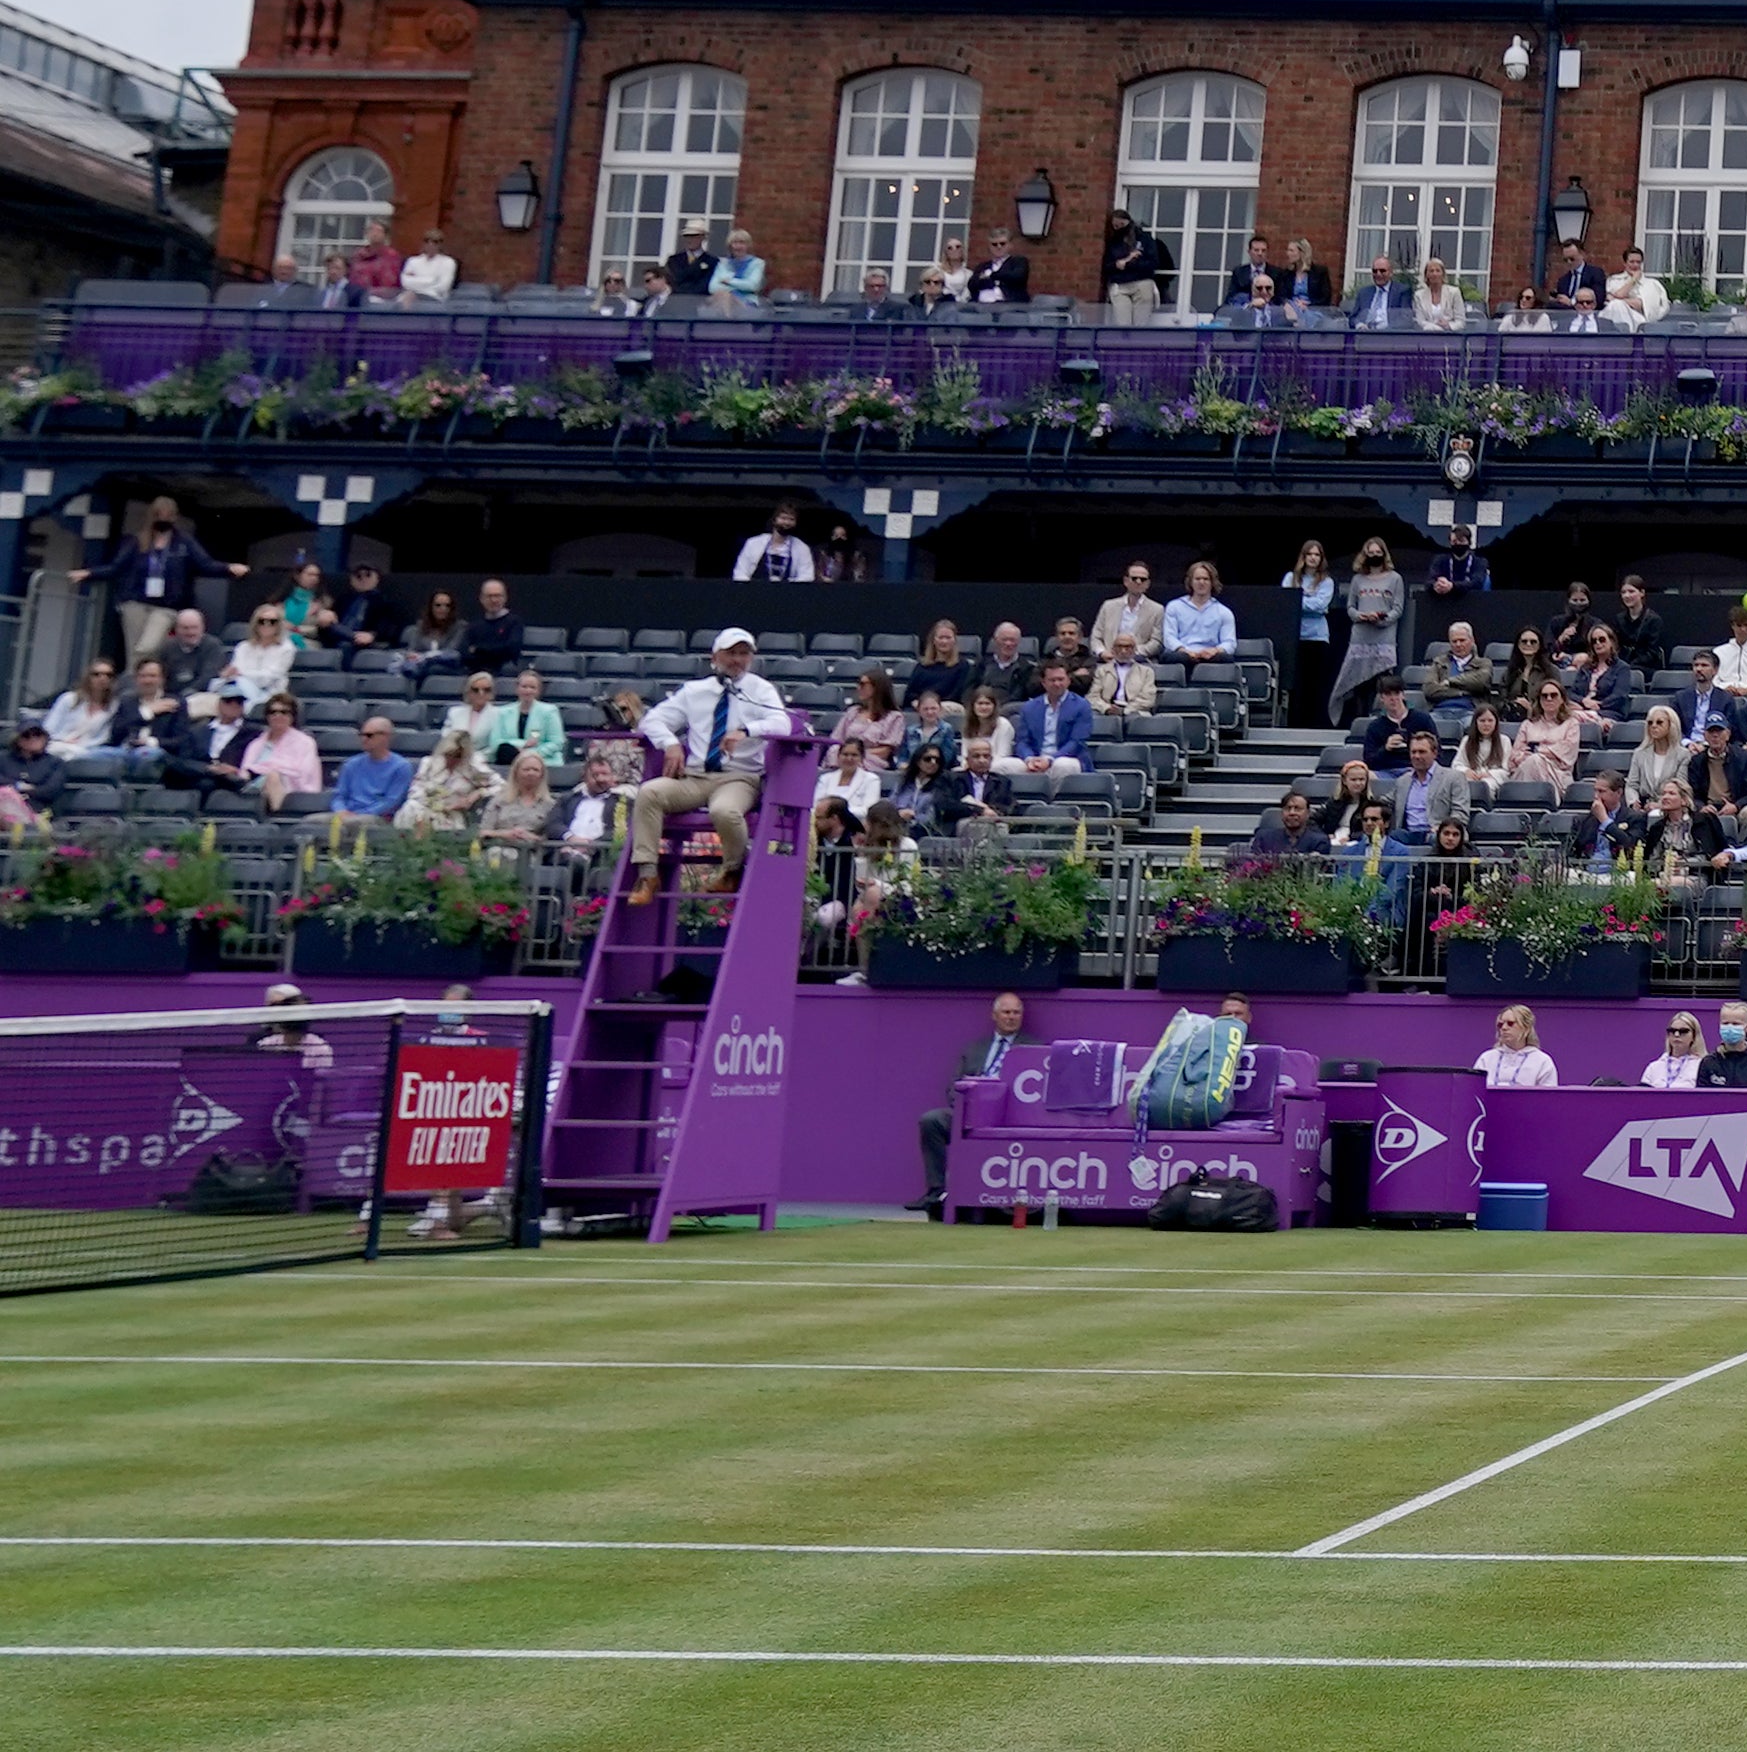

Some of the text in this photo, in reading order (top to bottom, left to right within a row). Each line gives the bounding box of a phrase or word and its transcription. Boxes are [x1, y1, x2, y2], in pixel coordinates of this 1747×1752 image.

[714, 1014, 785, 1076] cinch
[1212, 1026, 1243, 1103] HEAD
[398, 1071, 511, 1119] Emirates
[407, 1127, 439, 1166] FLY
[980, 1142, 1107, 1189] cinch
[1628, 1137, 1741, 1192] LTA
